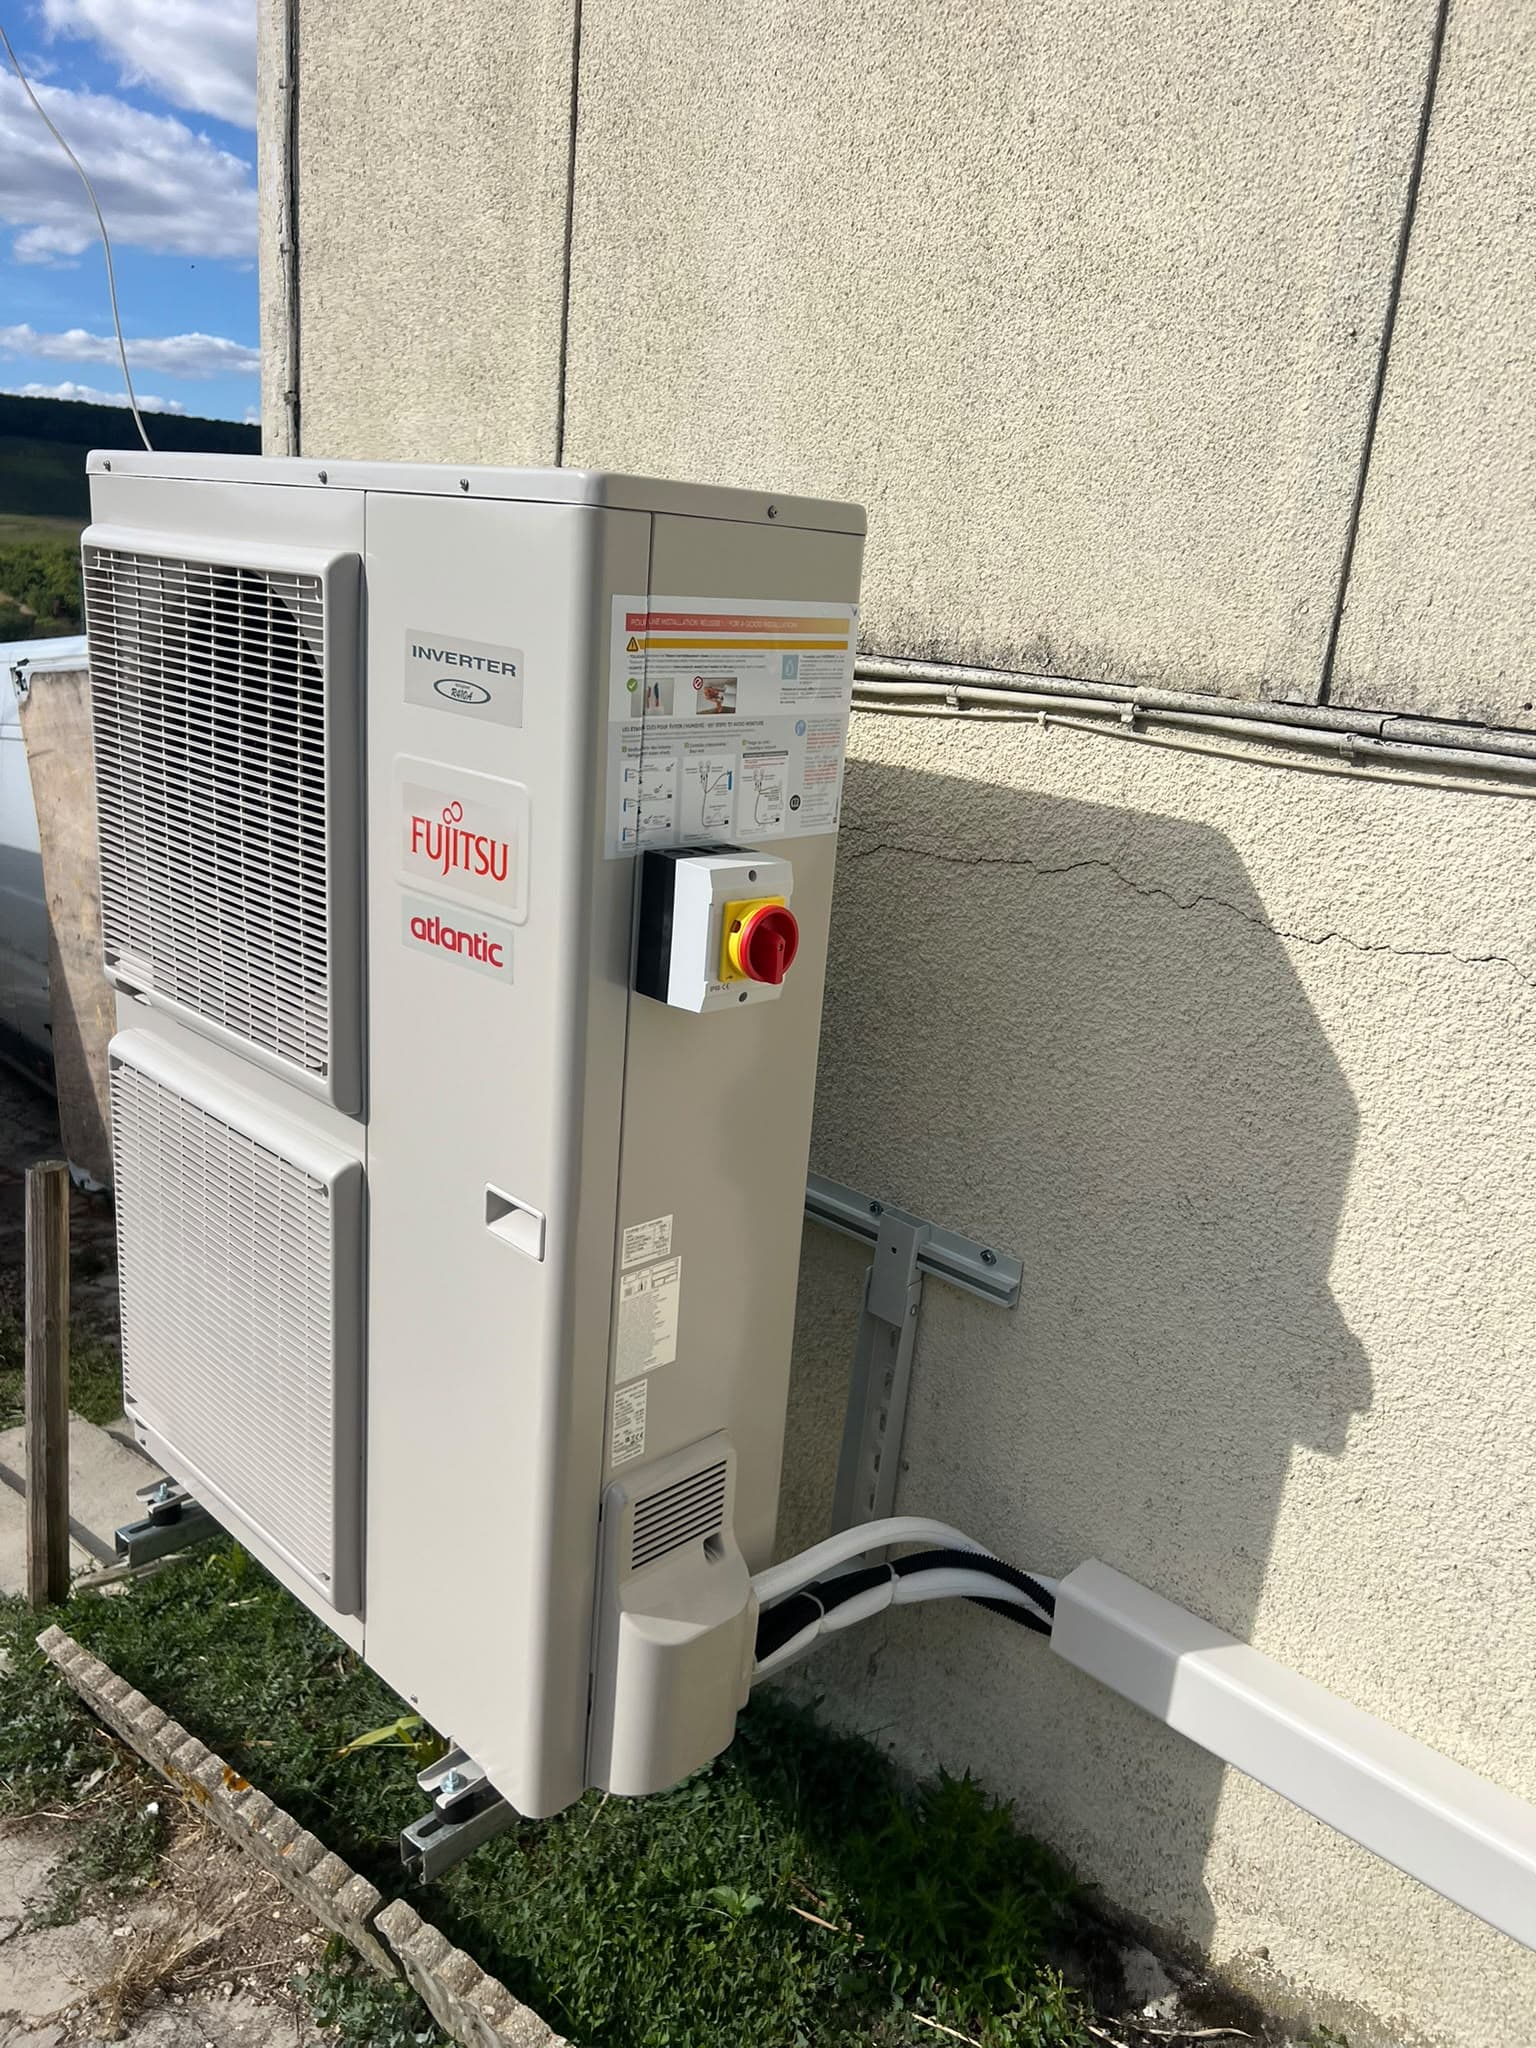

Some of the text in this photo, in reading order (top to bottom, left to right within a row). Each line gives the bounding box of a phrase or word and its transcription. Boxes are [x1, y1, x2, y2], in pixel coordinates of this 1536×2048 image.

[412, 644, 517, 678] INVERTER
[411, 815, 509, 881] FUJITSU
[411, 916, 503, 968] atlantic
